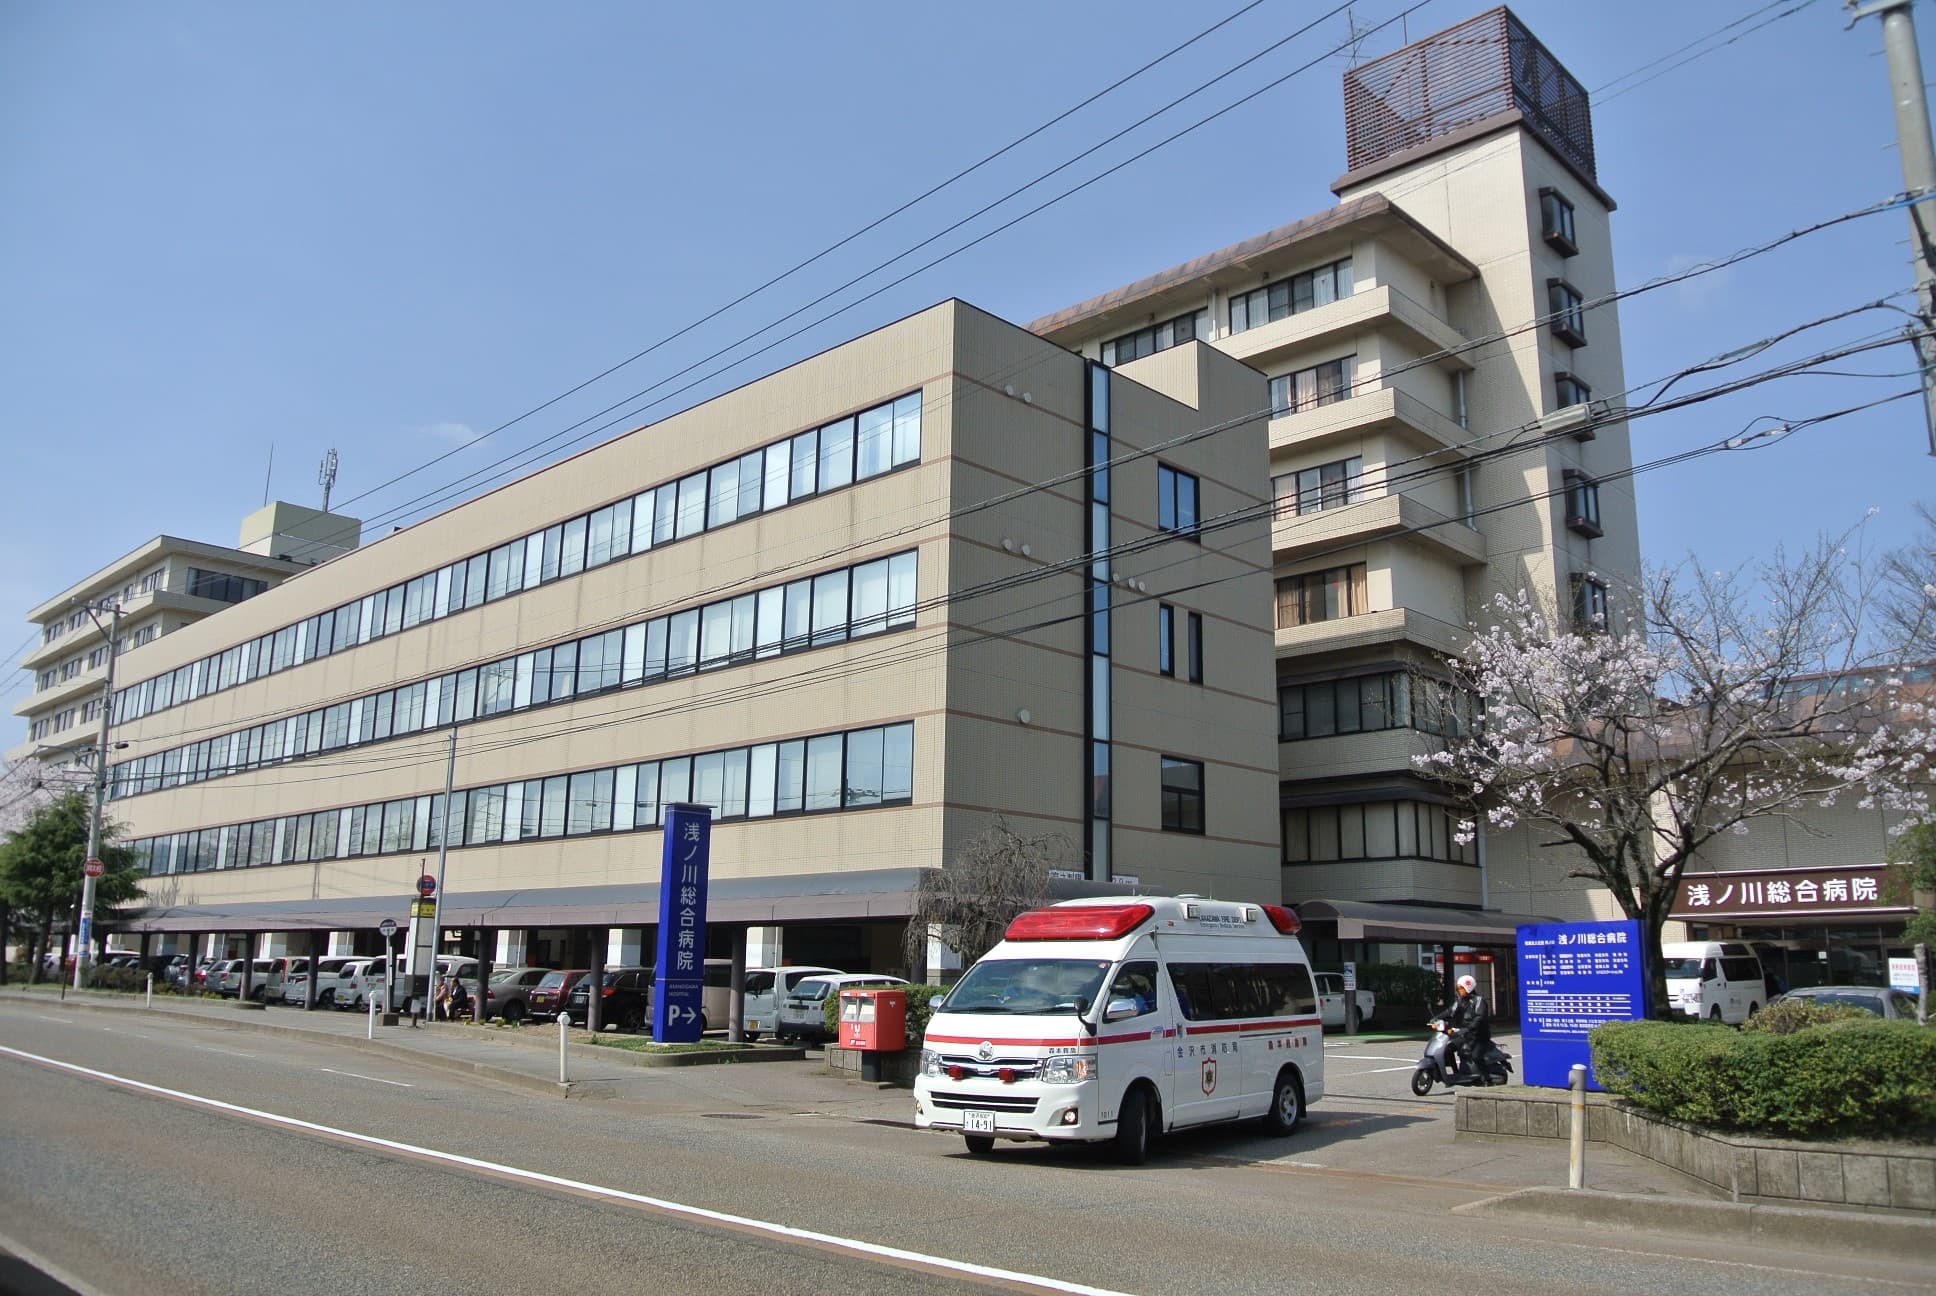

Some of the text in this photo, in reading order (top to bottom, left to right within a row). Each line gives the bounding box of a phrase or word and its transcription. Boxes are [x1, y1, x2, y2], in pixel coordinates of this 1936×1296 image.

[677, 822, 700, 971] 浅ノ川総合病院
[1687, 877, 1878, 906] 浅ノ川総合病院
[1558, 932, 1627, 945] 浅ノ川総合病院
[668, 1005, 680, 1026] P
[971, 1119, 992, 1131] 14-91
